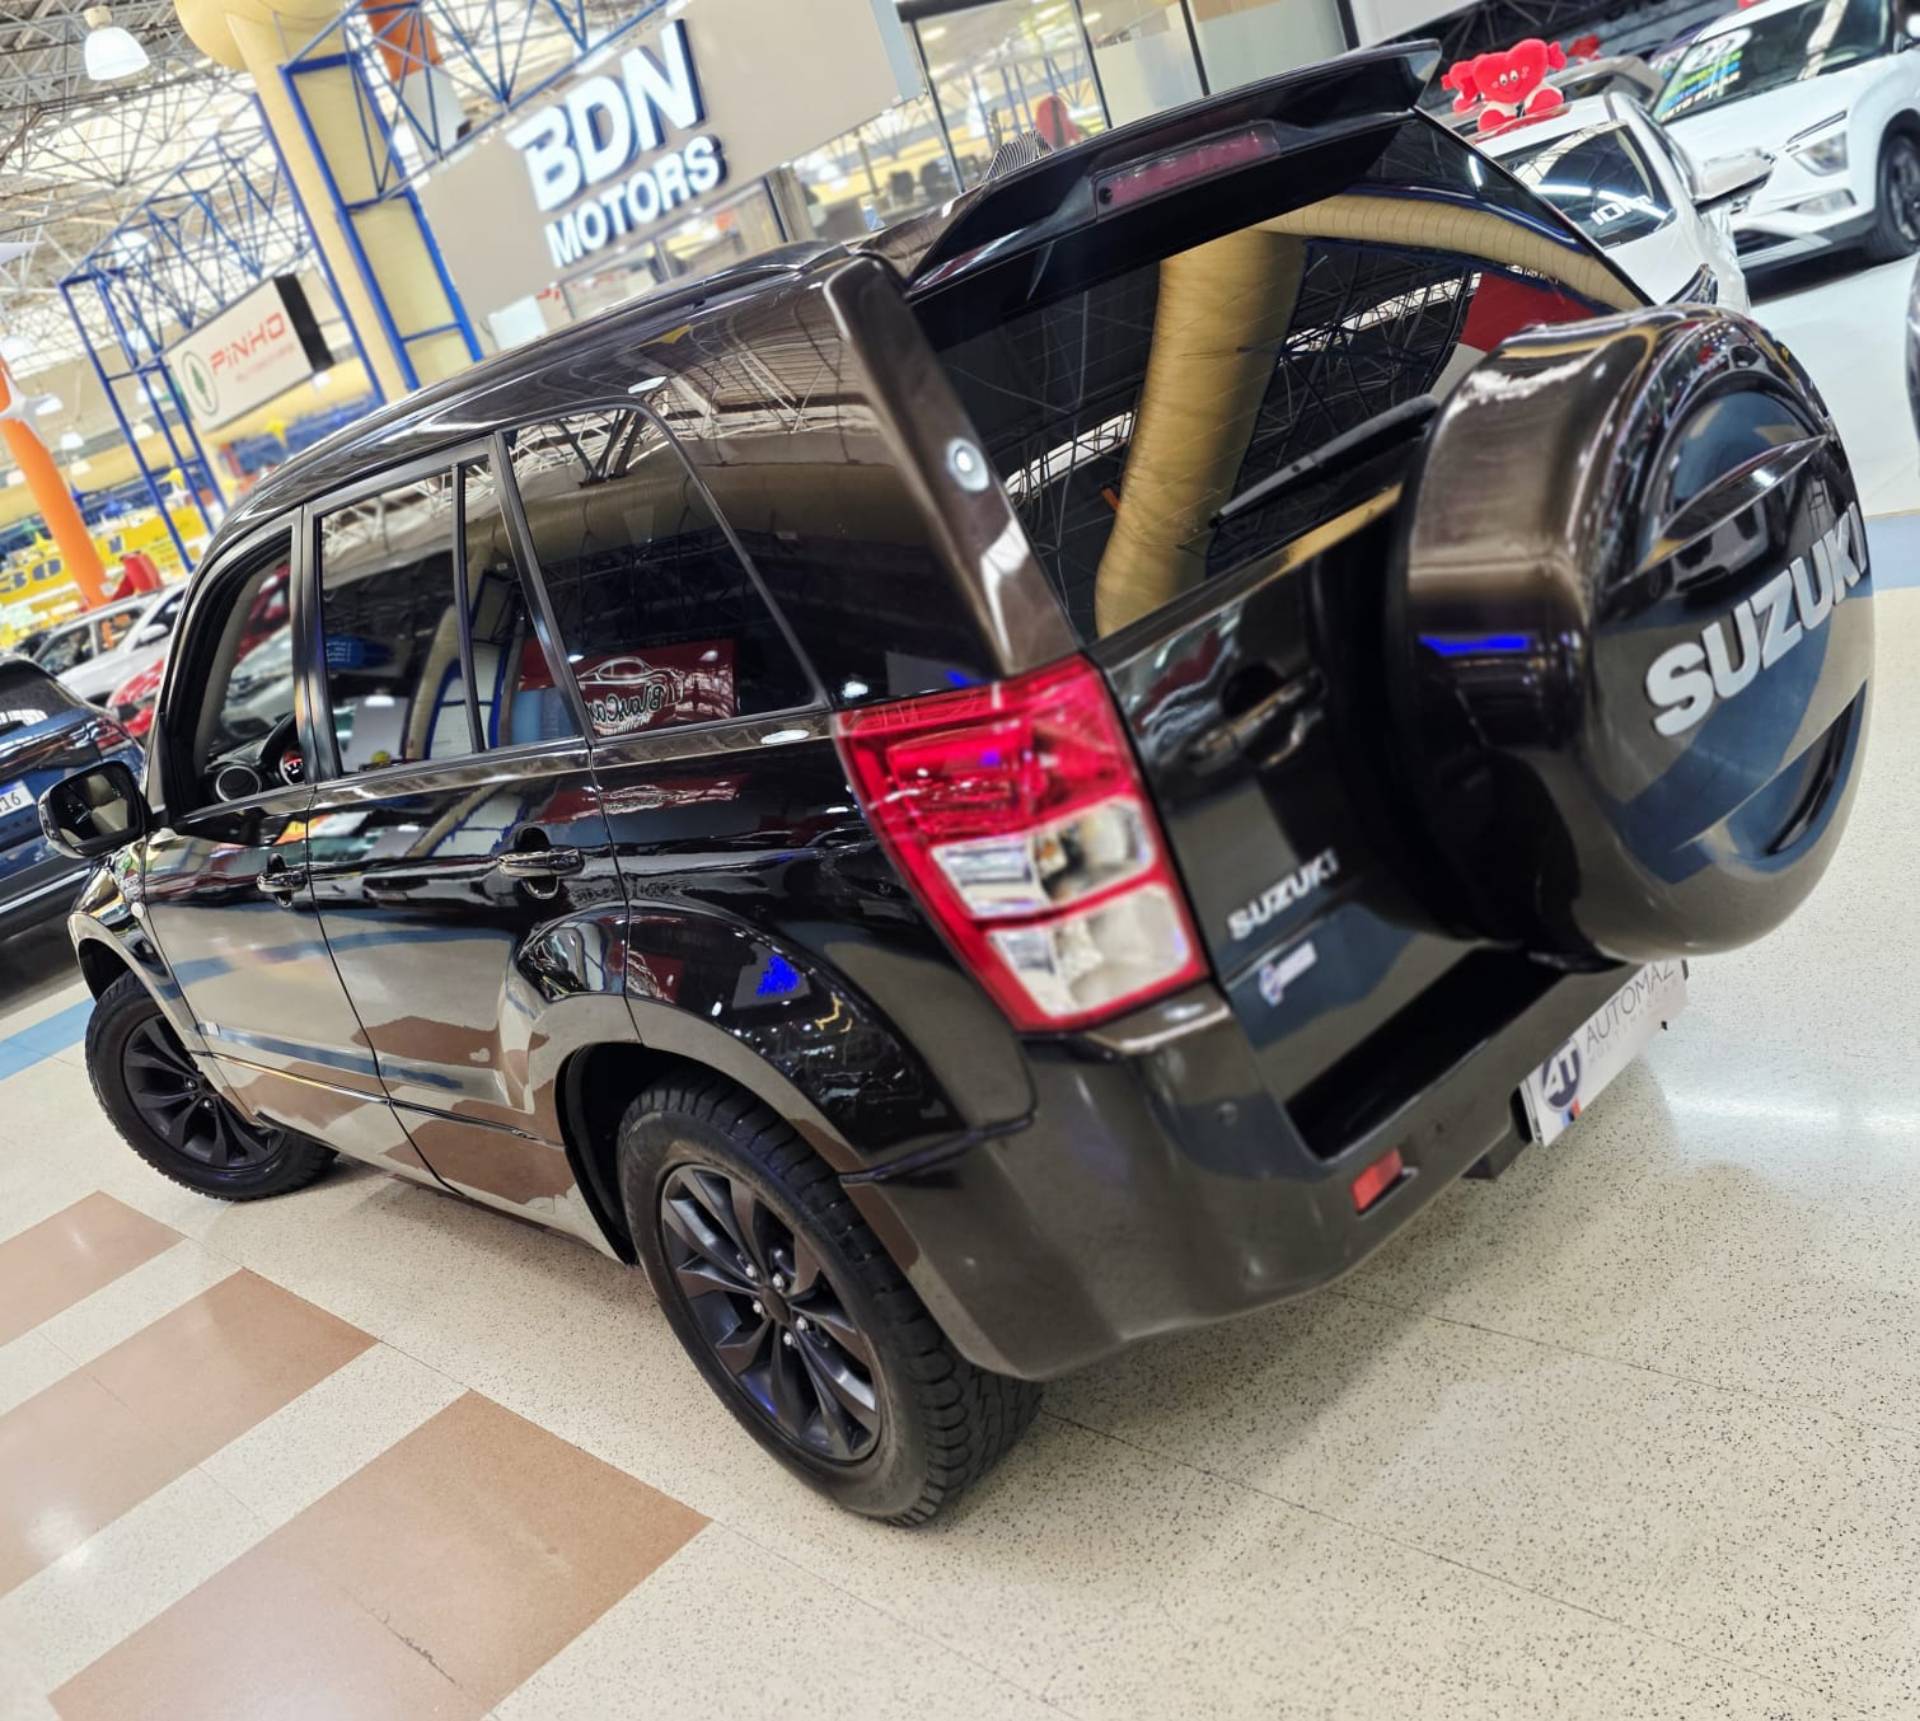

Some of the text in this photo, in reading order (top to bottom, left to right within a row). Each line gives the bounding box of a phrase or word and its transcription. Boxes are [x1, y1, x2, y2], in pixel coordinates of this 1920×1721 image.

[506, 18, 705, 213] BDN
[545, 134, 729, 268] MOTORS
[1645, 501, 1868, 736] SUZUKI
[0, 791, 21, 813] 16
[1227, 849, 1339, 941] SUZUKI
